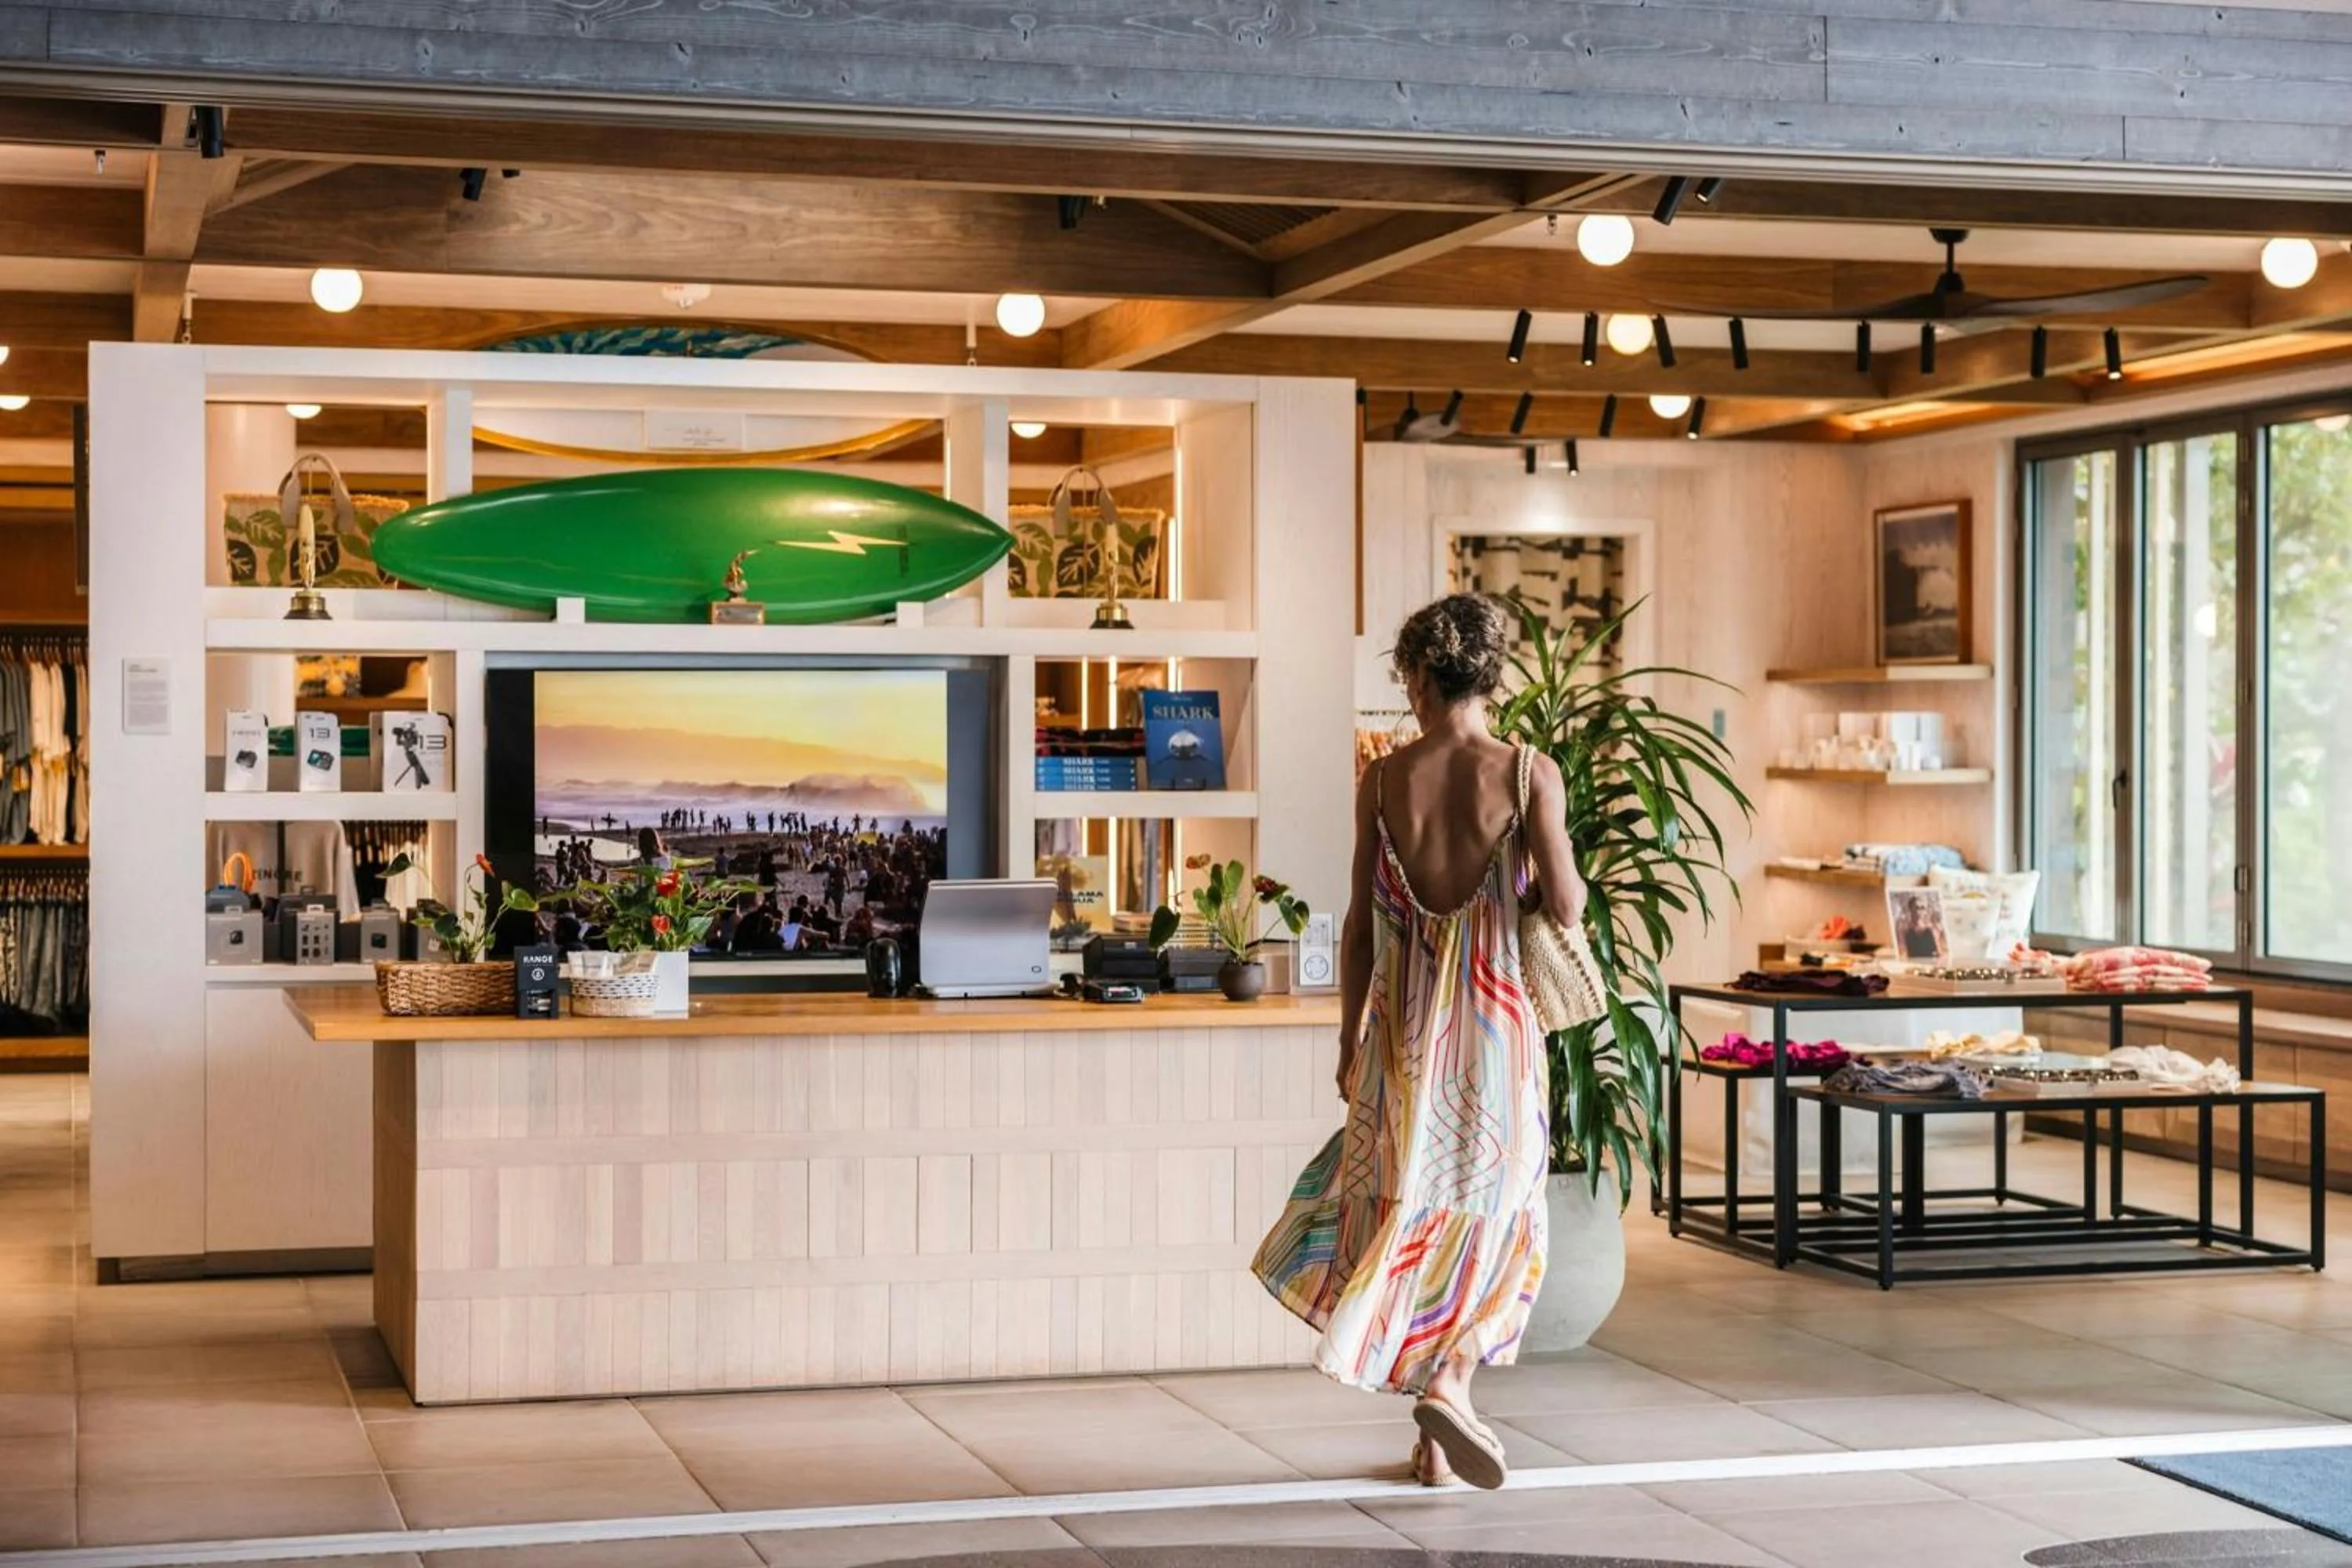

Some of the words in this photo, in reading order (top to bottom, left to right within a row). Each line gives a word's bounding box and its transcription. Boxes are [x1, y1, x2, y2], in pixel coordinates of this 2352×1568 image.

[1152, 705, 1214, 720] SHARK
[310, 728, 330, 739] 13
[419, 735, 448, 750] 13
